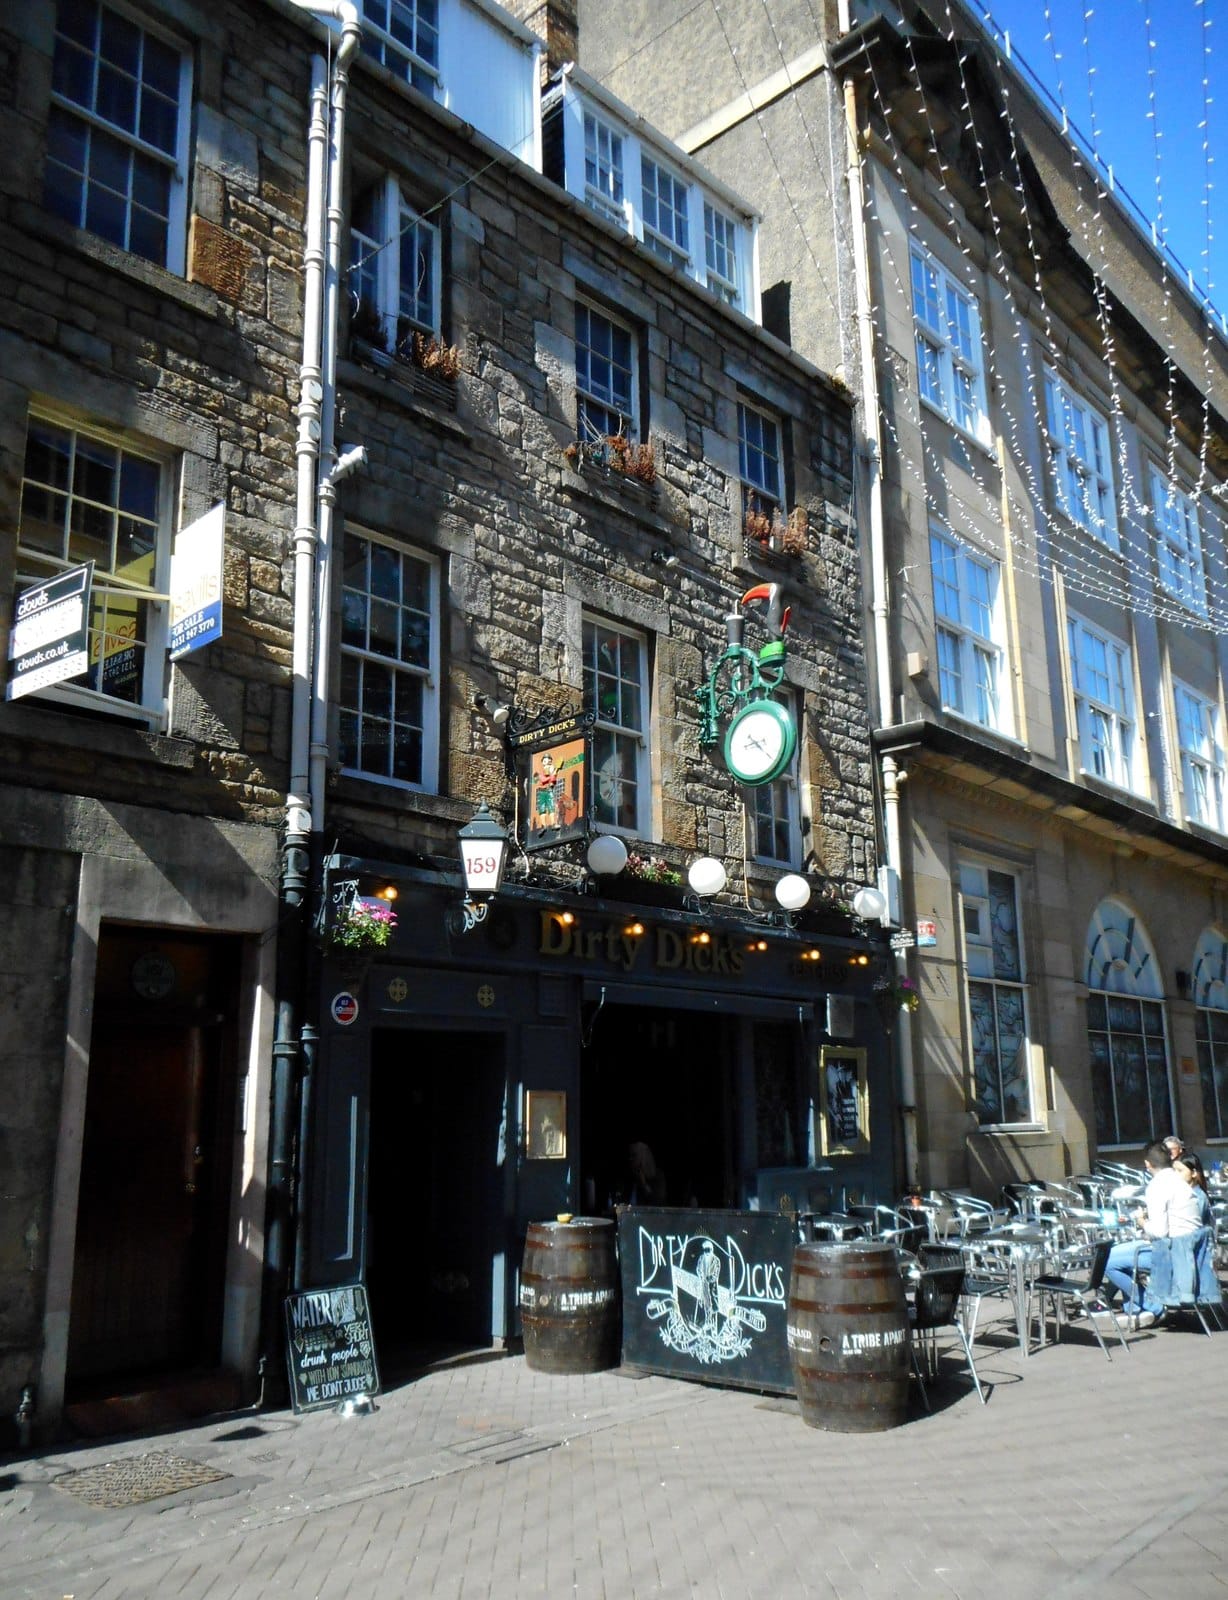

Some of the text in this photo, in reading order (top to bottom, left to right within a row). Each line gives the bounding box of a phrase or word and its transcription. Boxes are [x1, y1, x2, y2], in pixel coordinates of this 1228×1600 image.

[18, 590, 48, 616] clouds
[184, 611, 204, 631] SALE
[171, 633, 185, 649] 0131
[17, 641, 69, 672] clouds.co.uk
[519, 718, 576, 744] DIRTY DICK'S
[466, 857, 496, 874] 159
[538, 910, 646, 973] Dirty
[638, 1225, 785, 1300] DIRTY DICK'S
[291, 1292, 333, 1328] WATER
[343, 1320, 368, 1333] VERY
[344, 1328, 369, 1346] SHORT
[842, 1334, 850, 1349] A
[851, 1333, 881, 1349] TRIBE
[883, 1328, 906, 1347] APART
[300, 1343, 359, 1369] drunk people
[306, 1385, 321, 1402] WE
[344, 1375, 367, 1393] JUDGE
[308, 1369, 326, 1385] WITH
